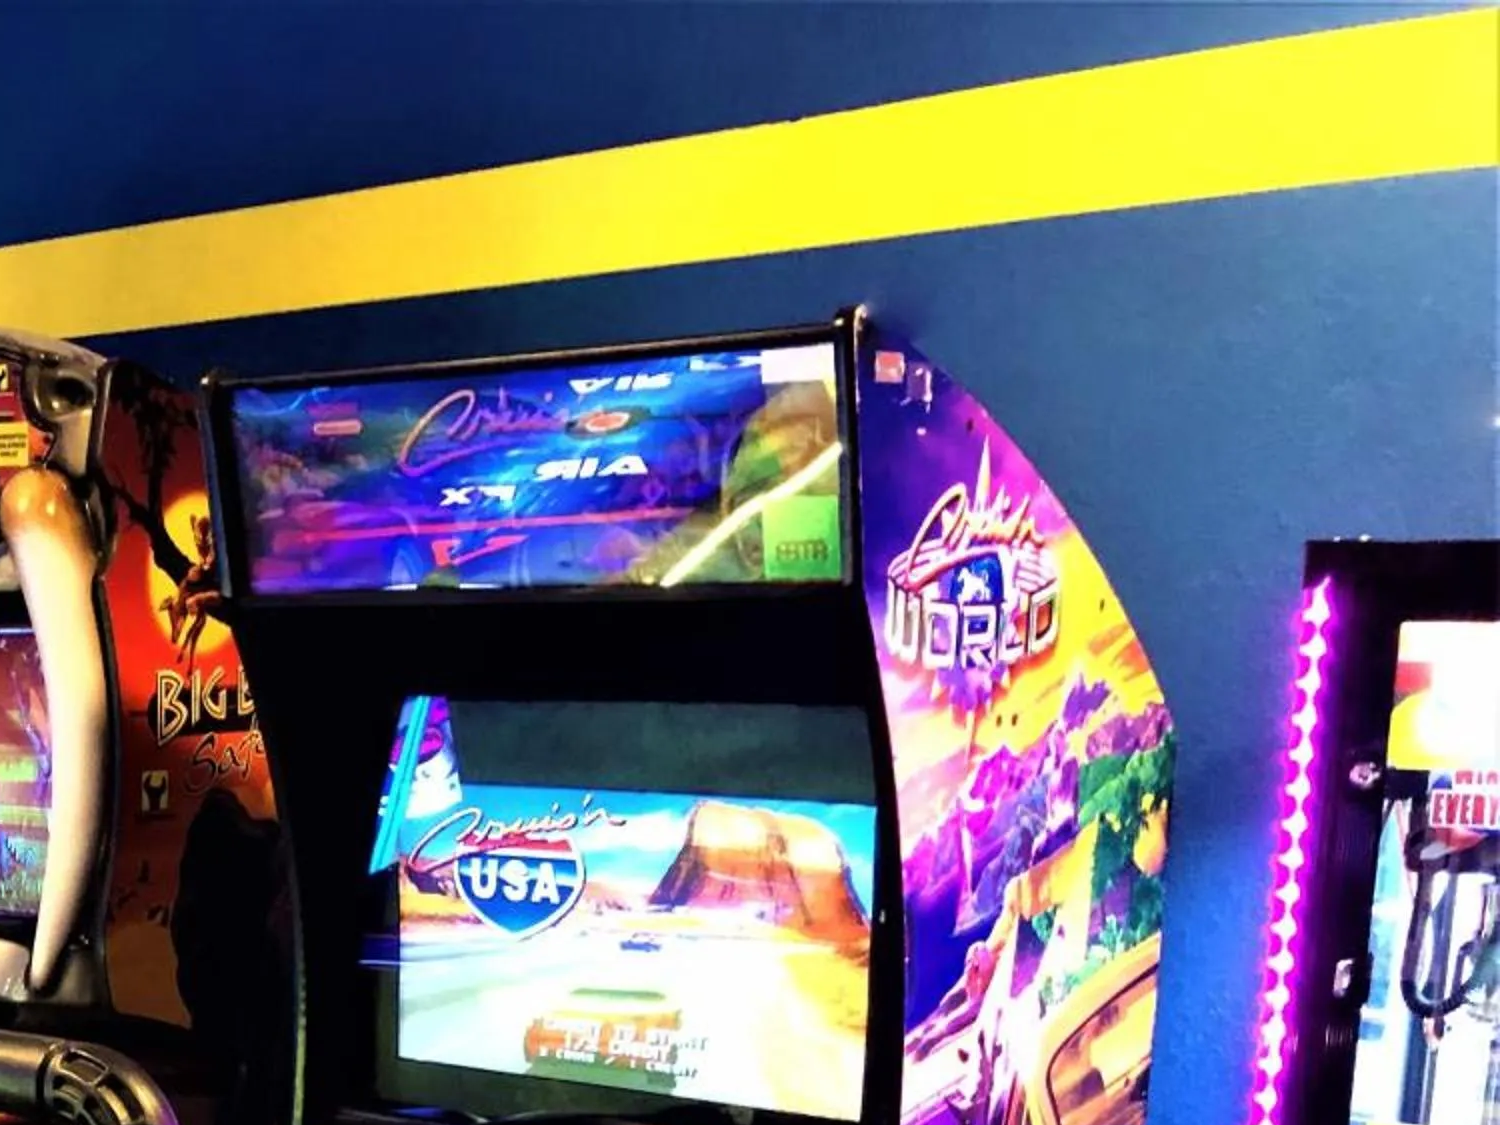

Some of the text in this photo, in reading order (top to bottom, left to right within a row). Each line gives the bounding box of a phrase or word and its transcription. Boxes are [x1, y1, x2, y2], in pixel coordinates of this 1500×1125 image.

[886, 576, 1058, 669] WORLD
[156, 668, 227, 746] BIG
[406, 792, 627, 873] Cruis'n
[470, 857, 561, 904] USA
